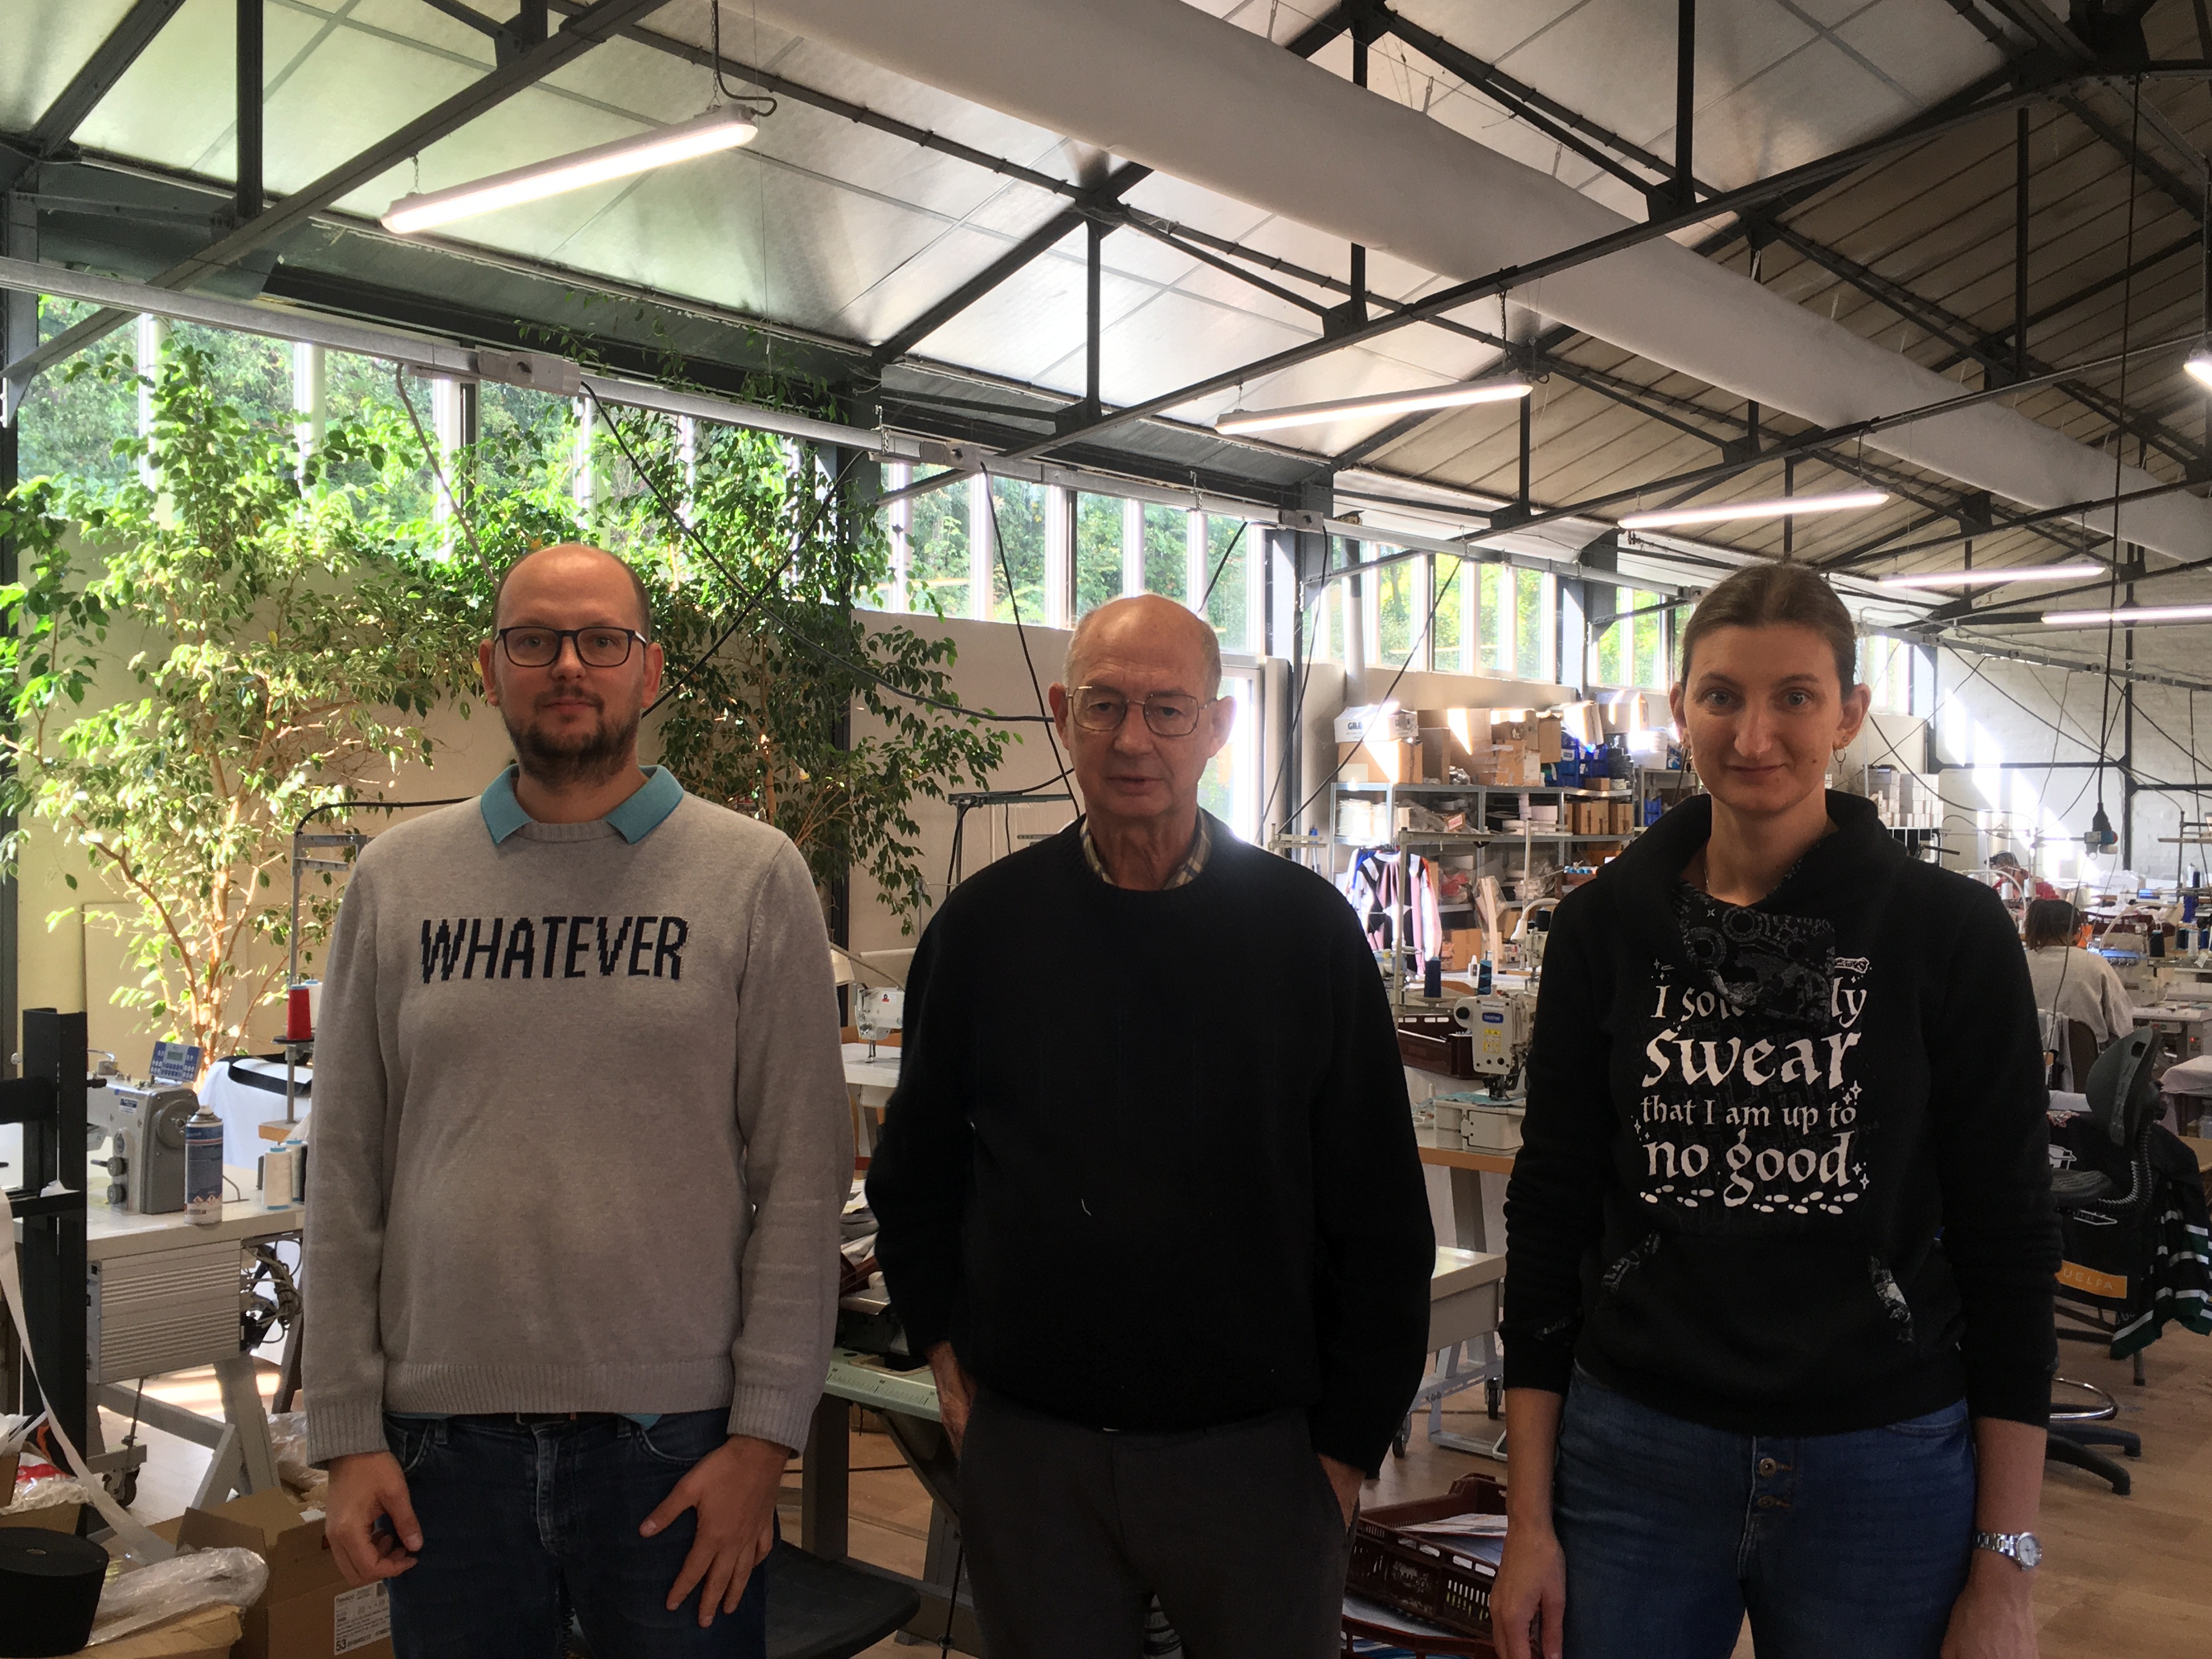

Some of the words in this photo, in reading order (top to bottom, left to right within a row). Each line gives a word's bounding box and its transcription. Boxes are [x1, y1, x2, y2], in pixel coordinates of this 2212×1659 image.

[421, 916, 689, 984] WHATEVER
[1650, 985, 1671, 1018] I
[1641, 1028, 1862, 1090] swear
[1640, 1094, 1696, 1126] that
[1704, 1099, 1716, 1125] I
[1726, 1106, 1771, 1127] am
[1781, 1105, 1819, 1136] up
[1826, 1101, 1857, 1129] to
[1642, 1141, 1709, 1179] no
[1723, 1127, 1855, 1207] good
[336, 1639, 347, 1651] 53
